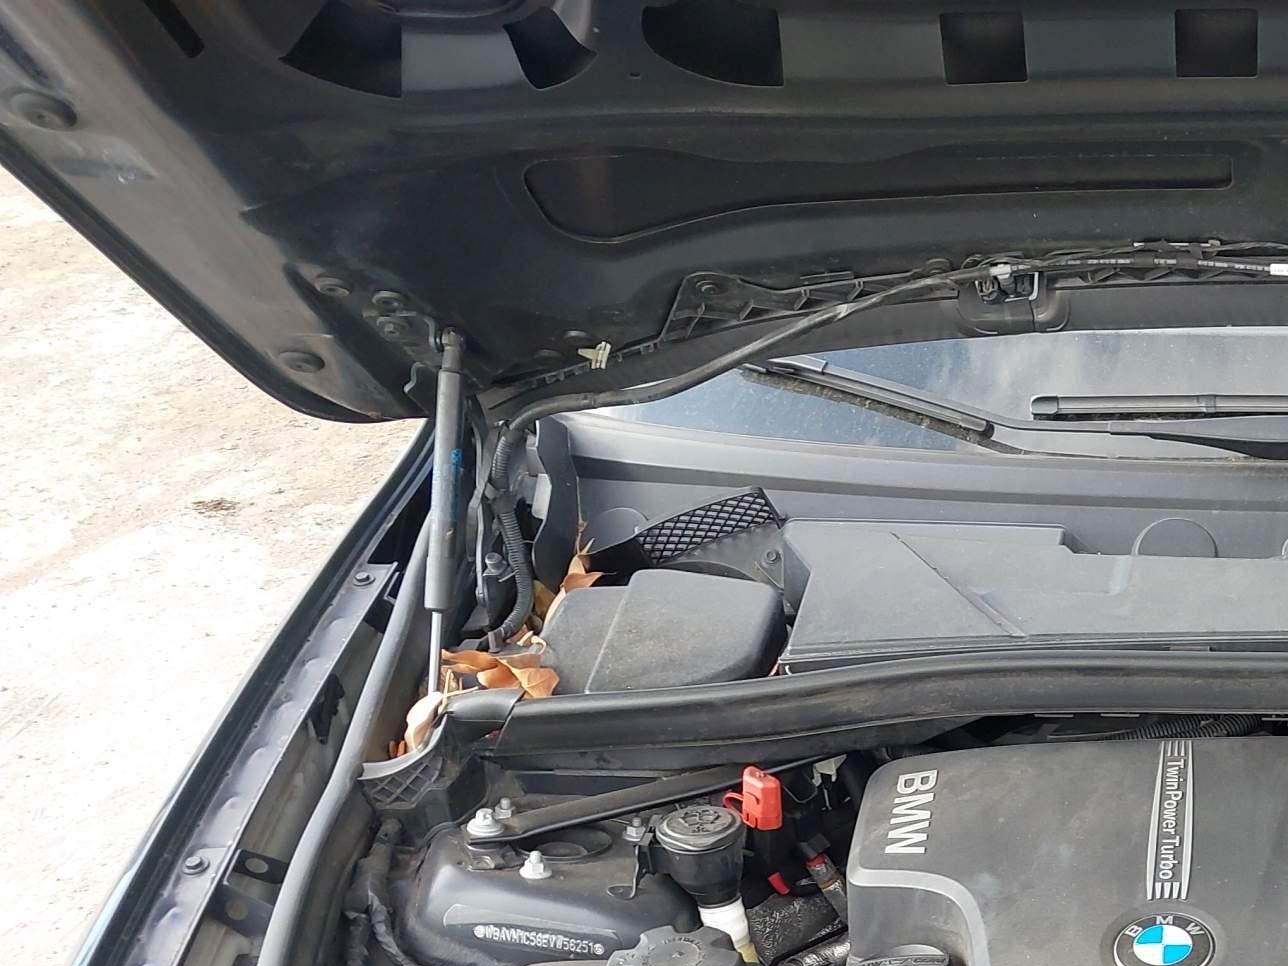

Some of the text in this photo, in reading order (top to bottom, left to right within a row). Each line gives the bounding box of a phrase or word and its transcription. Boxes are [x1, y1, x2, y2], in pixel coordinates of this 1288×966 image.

[884, 769, 938, 854] BMW
[1158, 758, 1185, 881] TwinPower Turbo
[1125, 915, 1205, 938] BMW
